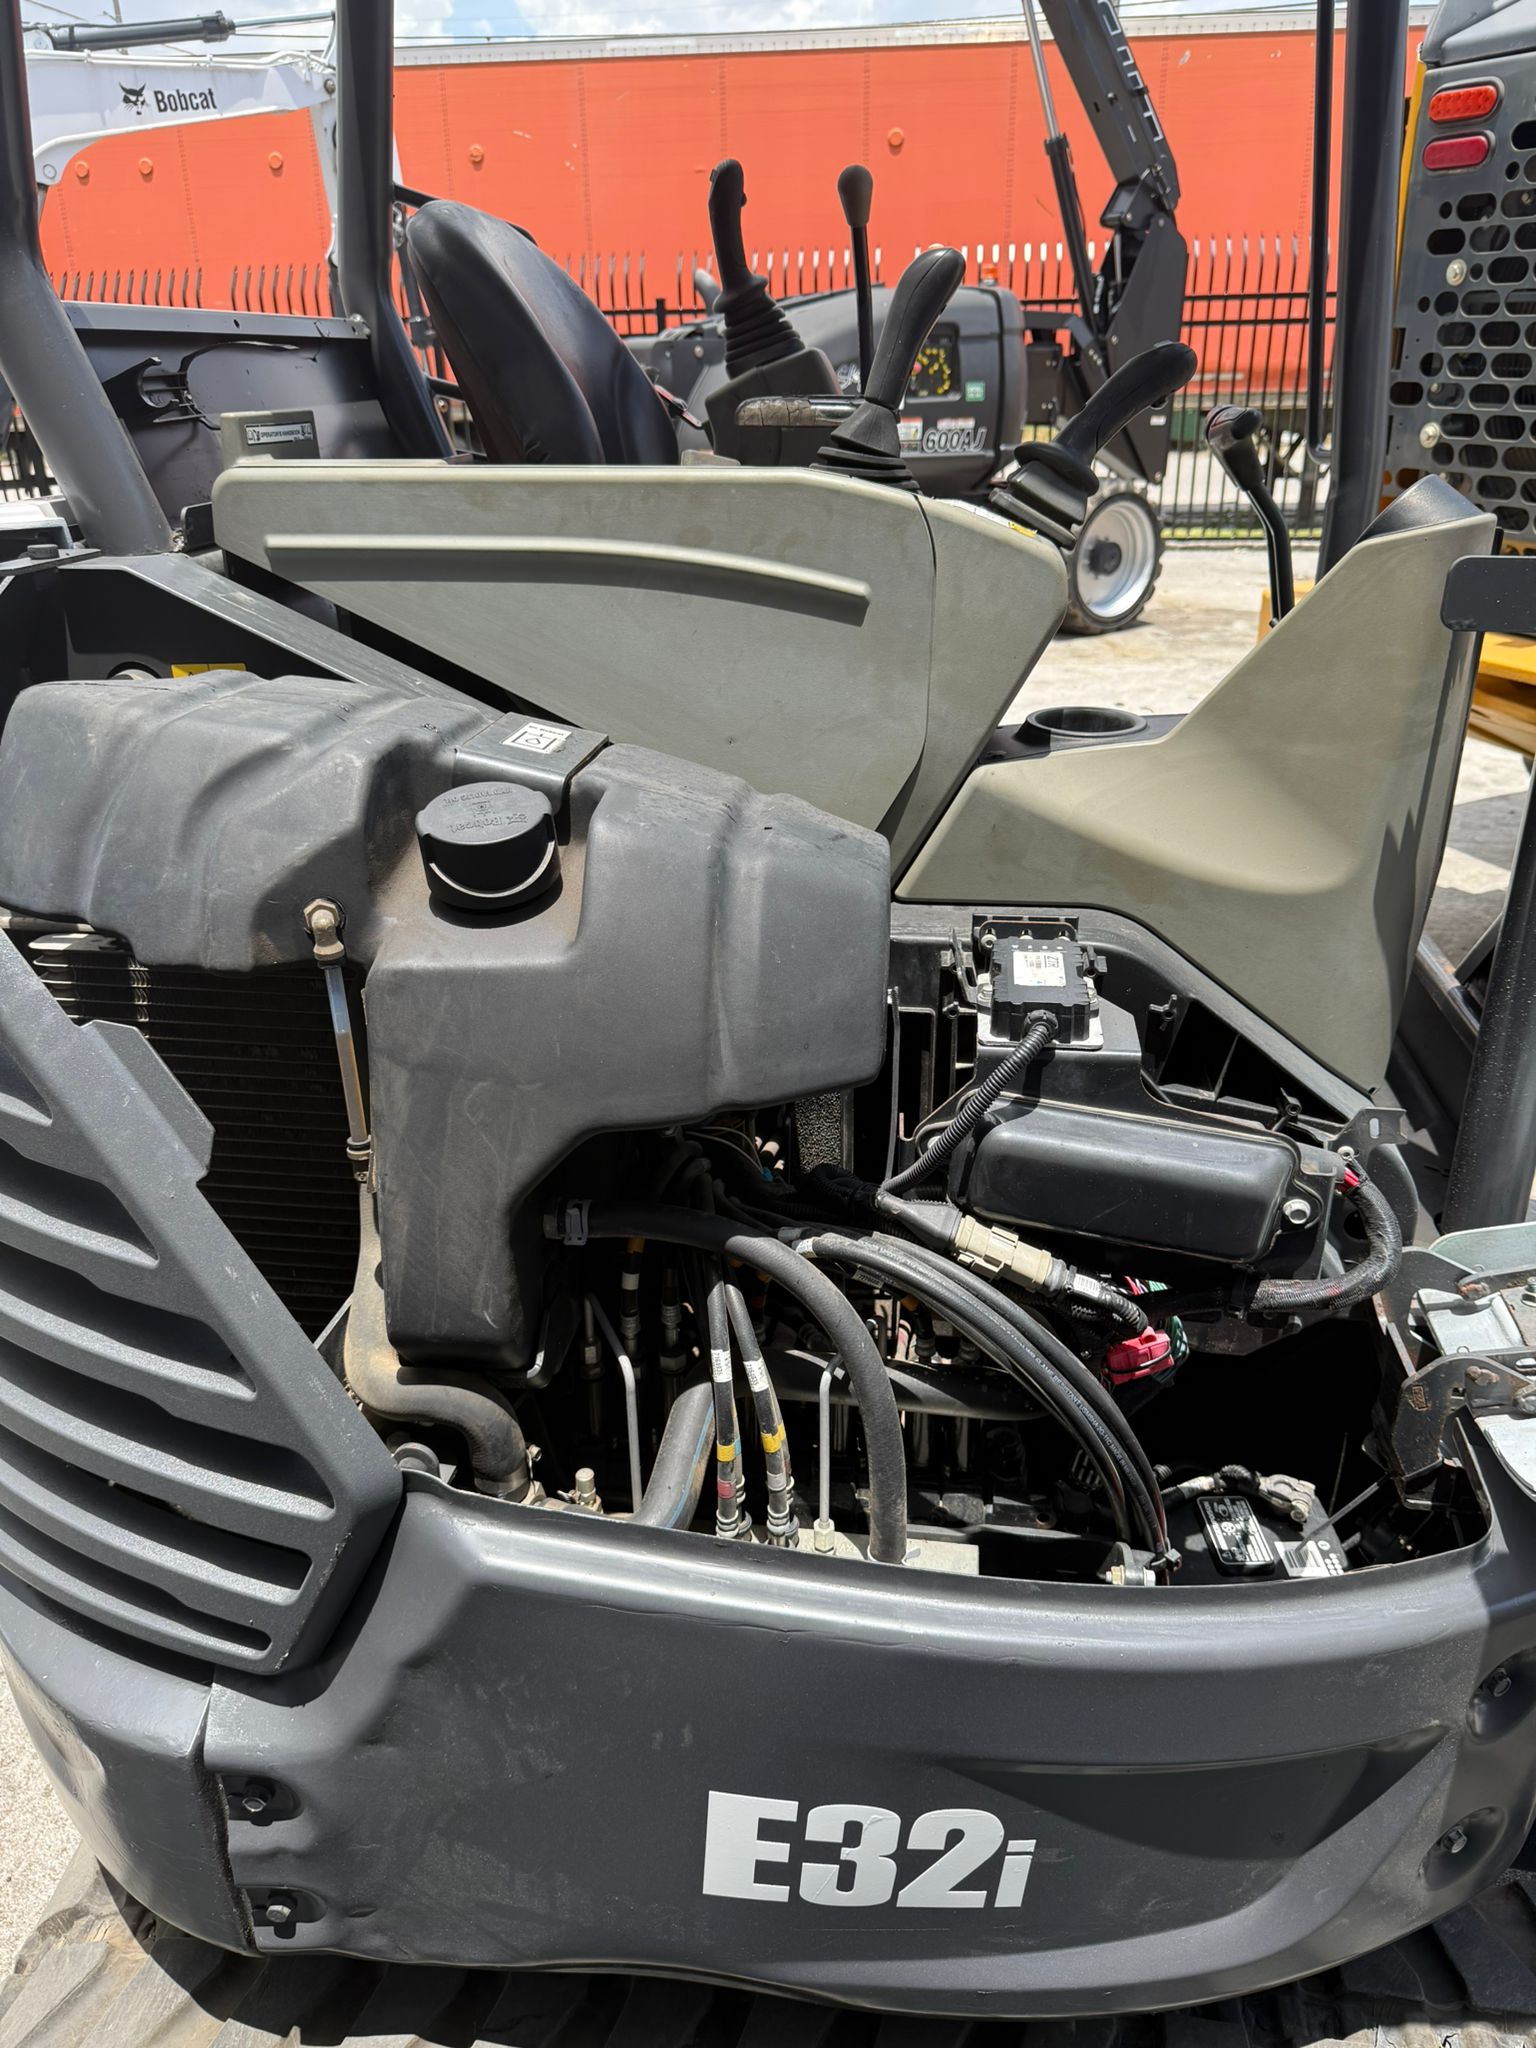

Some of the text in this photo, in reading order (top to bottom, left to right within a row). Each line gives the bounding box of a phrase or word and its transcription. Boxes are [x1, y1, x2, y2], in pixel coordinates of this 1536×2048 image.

[153, 87, 217, 113] Bobcat
[922, 425, 988, 453] 600AJ
[1051, 1374, 1081, 1406] RESISTANT
[702, 1789, 1038, 1909] E32i
